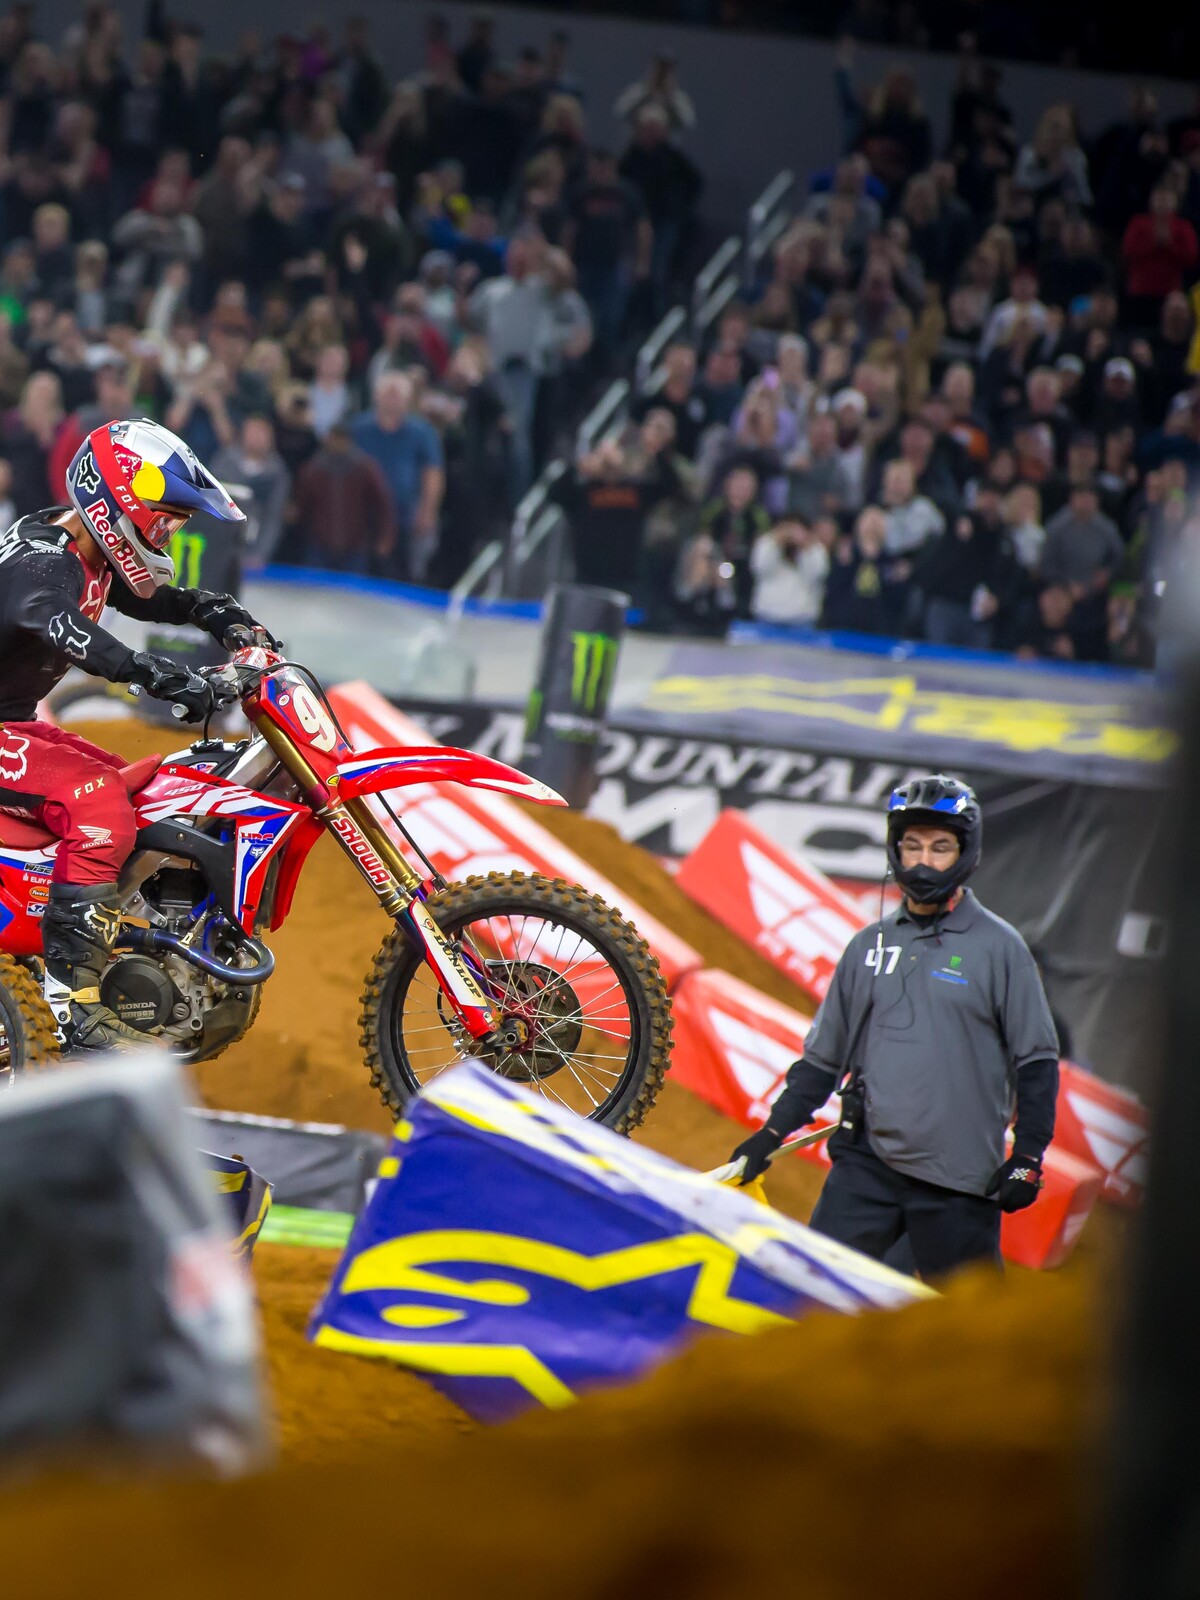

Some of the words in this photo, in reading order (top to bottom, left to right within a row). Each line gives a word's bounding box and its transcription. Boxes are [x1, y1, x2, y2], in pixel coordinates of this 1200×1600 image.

[116, 486, 140, 512] FOX
[85, 498, 125, 549] Red
[111, 540, 153, 586] Bull
[73, 776, 106, 800] FOX
[81, 839, 114, 849] HONDA
[241, 832, 274, 845] HRC
[331, 817, 392, 886] SHOWA
[433, 934, 482, 999] DUNLOP
[864, 932, 903, 976] 47
[117, 1001, 157, 1010] HONDA
